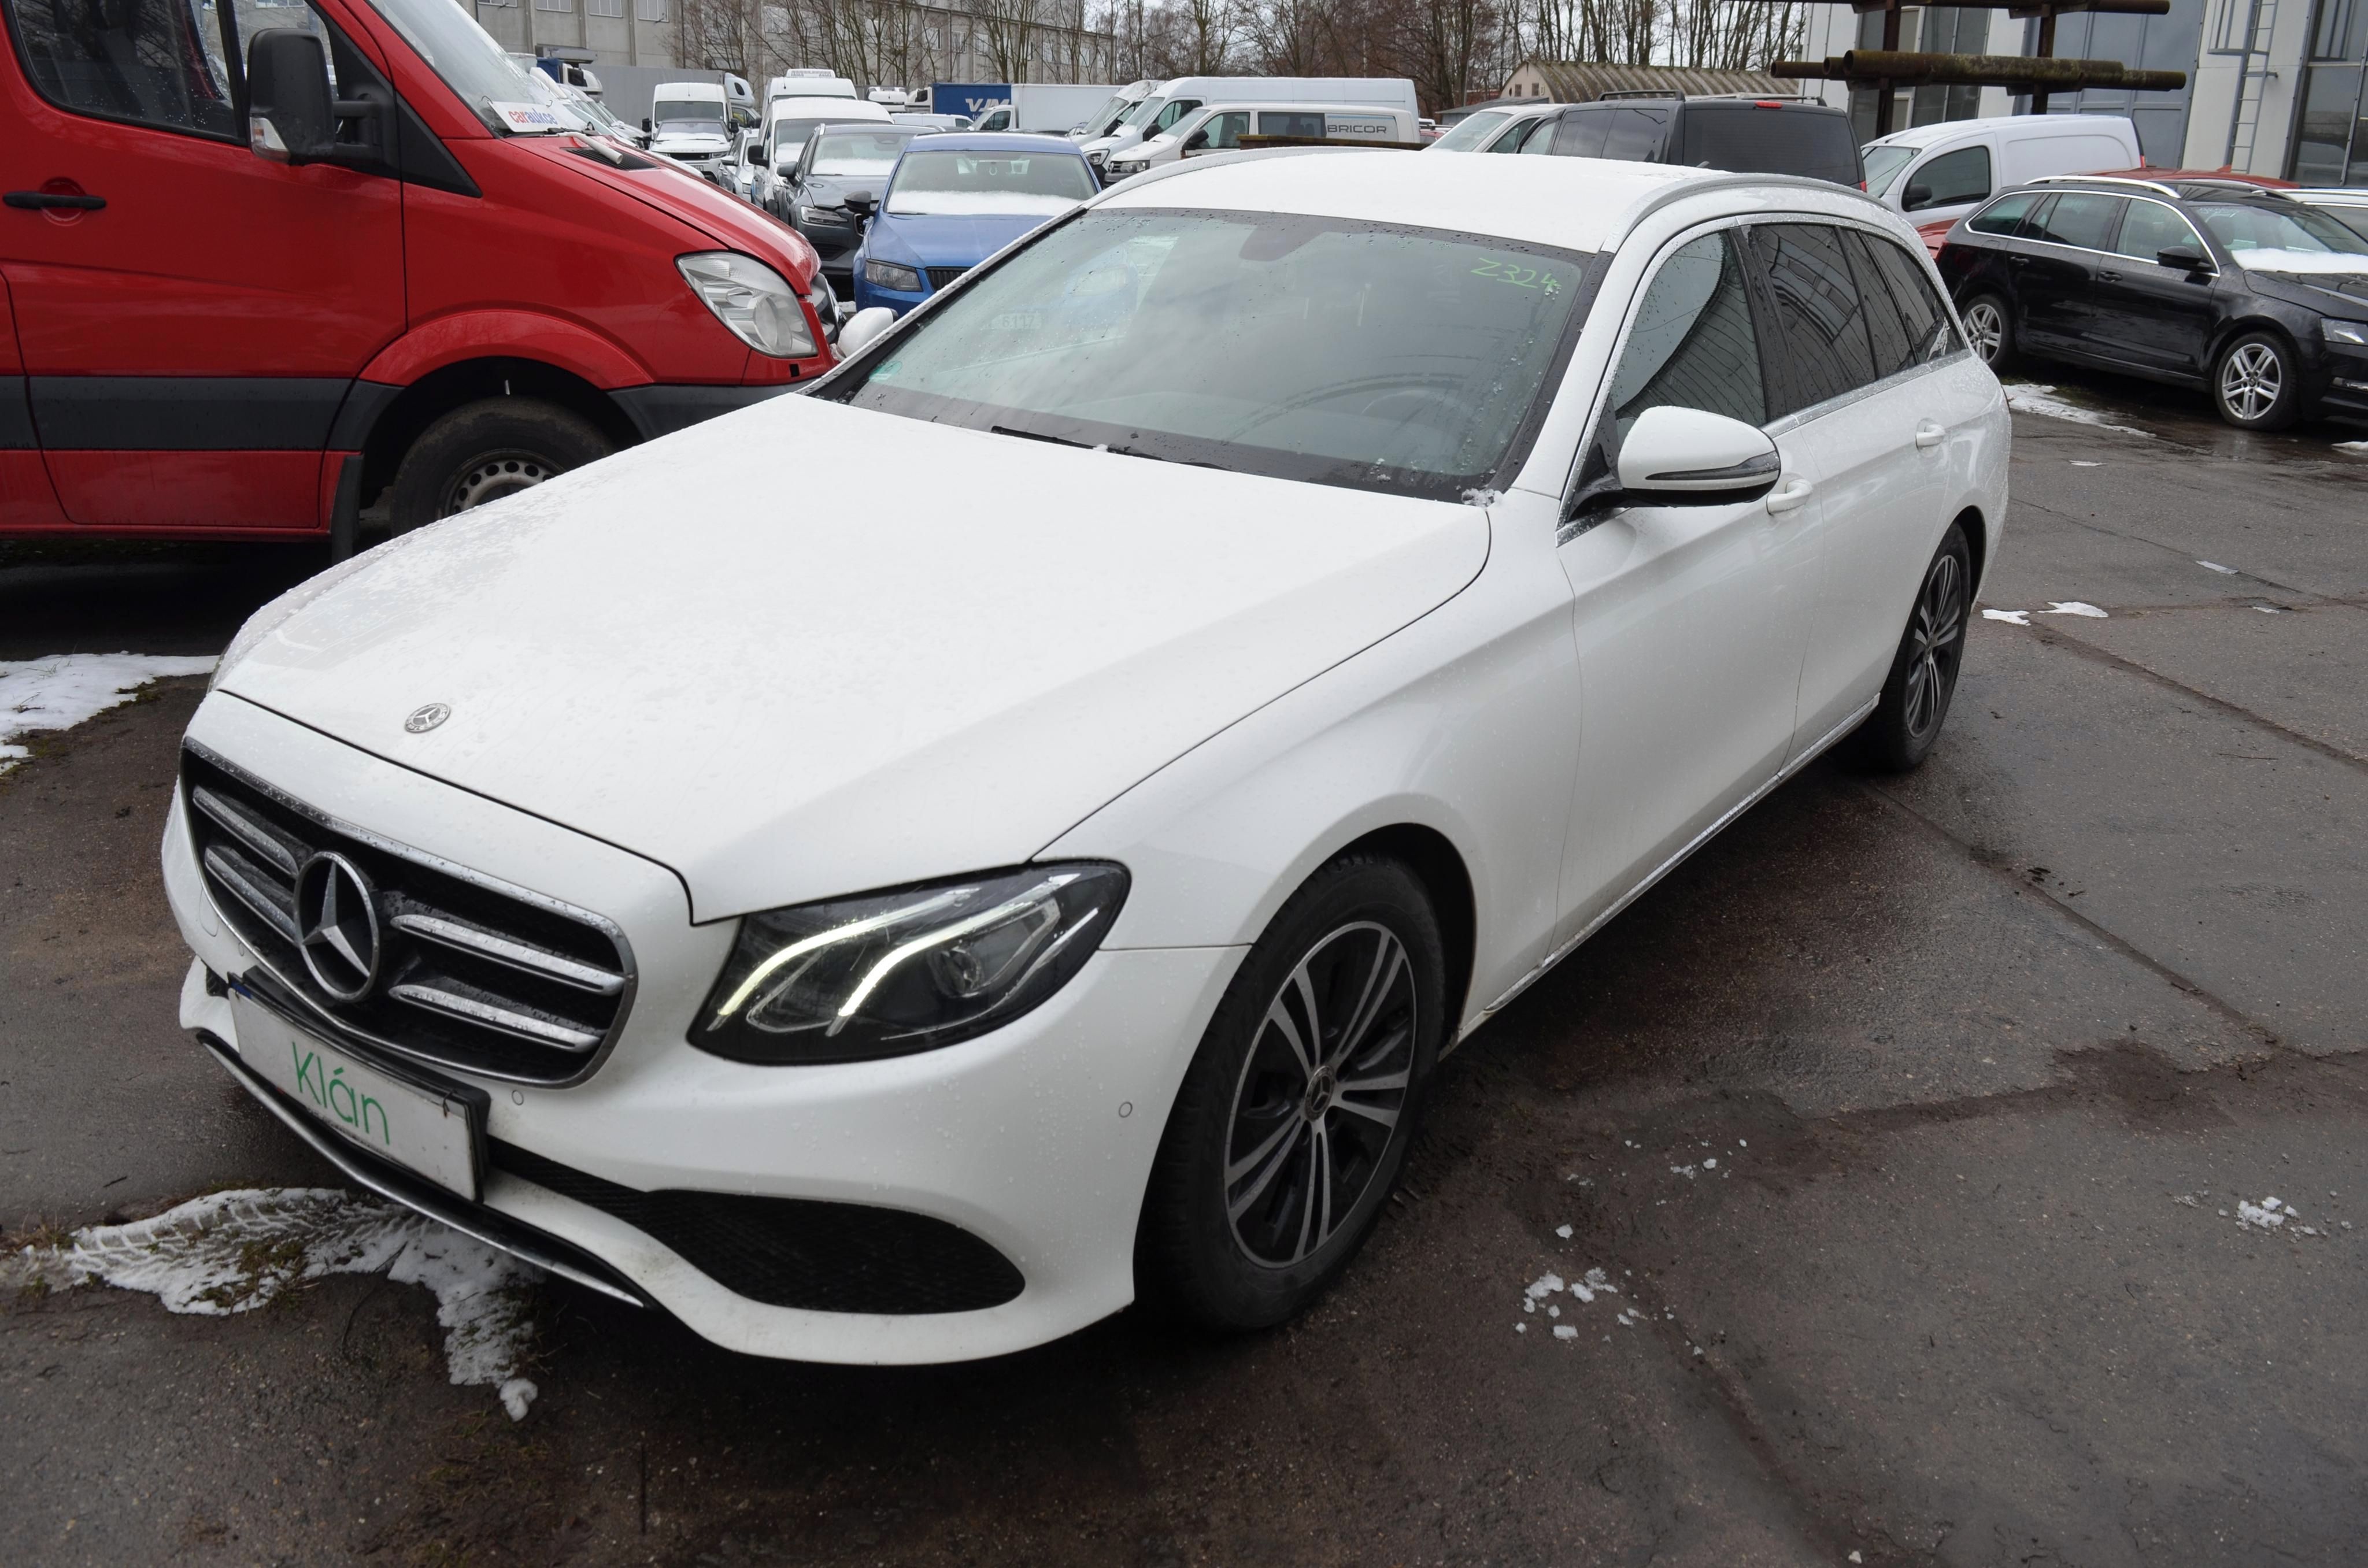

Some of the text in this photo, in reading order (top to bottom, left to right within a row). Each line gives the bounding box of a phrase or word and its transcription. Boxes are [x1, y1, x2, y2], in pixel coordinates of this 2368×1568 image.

[508, 108, 558, 124] caraukce
[1327, 124, 1387, 134] BRICOR
[292, 1041, 391, 1145] Klán
